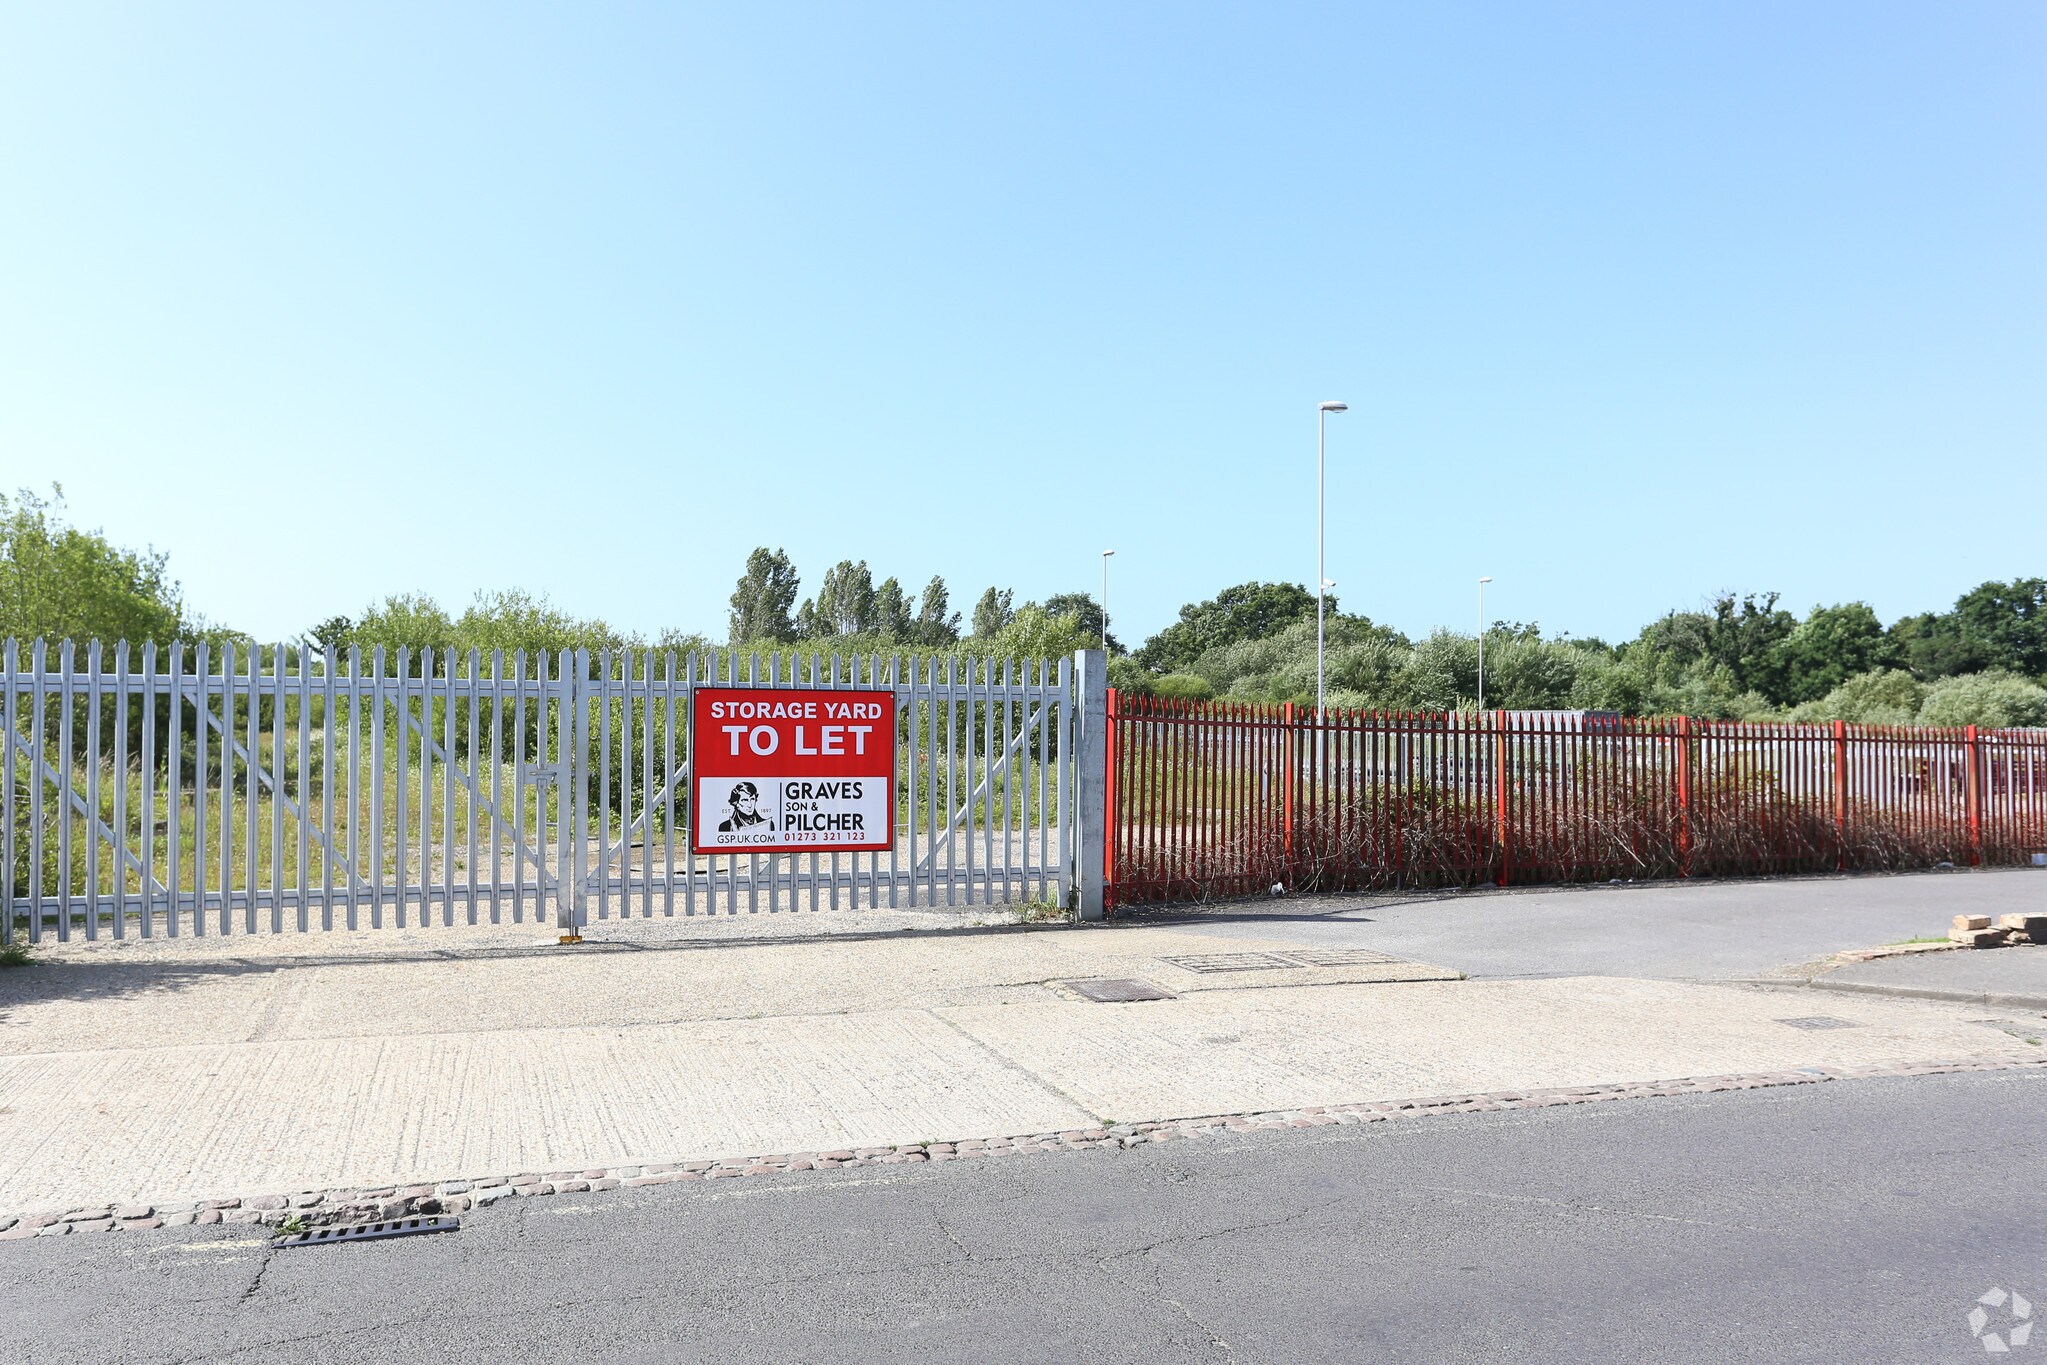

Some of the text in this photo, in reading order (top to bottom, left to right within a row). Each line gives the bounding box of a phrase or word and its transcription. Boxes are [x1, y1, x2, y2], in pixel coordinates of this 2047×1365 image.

[710, 701, 882, 719] STORAGE YARD
[721, 724, 873, 756] TO LET
[785, 781, 863, 800] GRAVES
[785, 801, 819, 812] SON &
[785, 813, 864, 832] PILCHER
[717, 834, 776, 844] GSP.UK.COM
[784, 831, 865, 842] 01273 321 123
